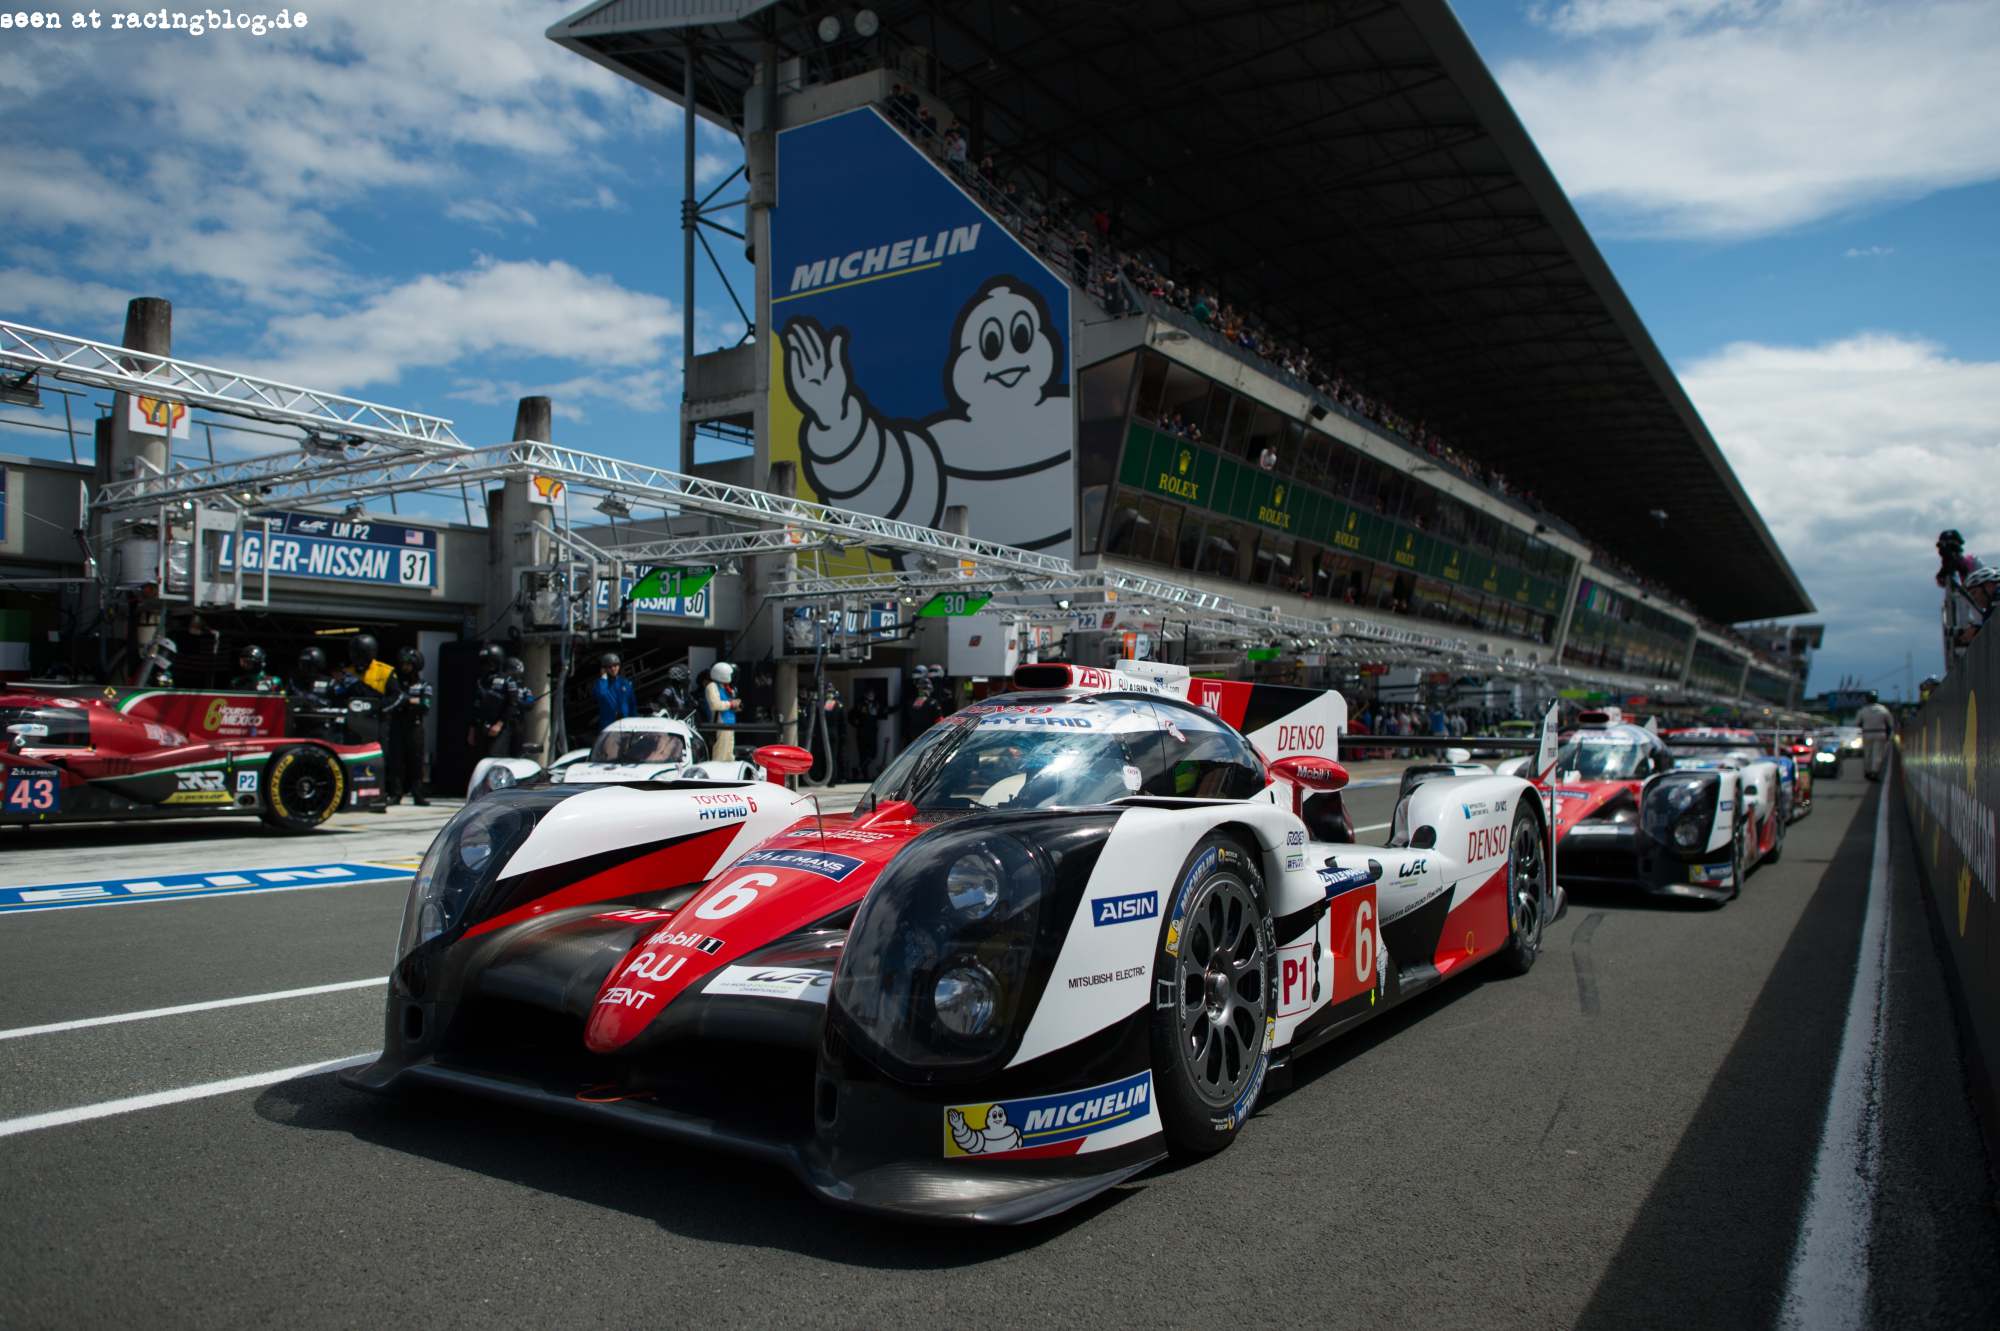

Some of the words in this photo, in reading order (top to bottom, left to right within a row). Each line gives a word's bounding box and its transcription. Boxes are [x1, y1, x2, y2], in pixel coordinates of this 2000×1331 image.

[790, 223, 982, 292] MICHELIN
[1158, 472, 1199, 500] ROLEX
[1258, 505, 1291, 529] ROLEX
[332, 521, 350, 538] LM
[352, 524, 370, 540] P2
[403, 555, 428, 582] 31
[659, 571, 682, 596] 31
[686, 592, 704, 614] 30
[943, 594, 966, 614] 30
[1079, 613, 1097, 630] 22
[1079, 666, 1113, 690] ZENT
[979, 716, 1093, 729] HYBRID
[1277, 724, 1326, 752] DENSO
[239, 775, 256, 788] P2
[10, 779, 54, 809] 43
[693, 794, 743, 805] TOYOTA
[747, 796, 758, 813] 6
[699, 806, 748, 820] HYBRID
[1467, 825, 1508, 864] DENSO
[792, 856, 846, 871] MANS
[1398, 859, 1428, 878] WEC
[695, 872, 778, 920] 6
[1099, 896, 1156, 922] AISIN
[643, 931, 704, 949] Mobil
[702, 939, 715, 952] 1
[1355, 899, 1374, 983] 6
[1068, 972, 1114, 990] MITSUBISHI
[1115, 965, 1146, 981] ELECTRIC
[1282, 956, 1309, 1005] P1
[598, 987, 657, 1010] ZENT
[1023, 1081, 1149, 1132] MICHELIN
